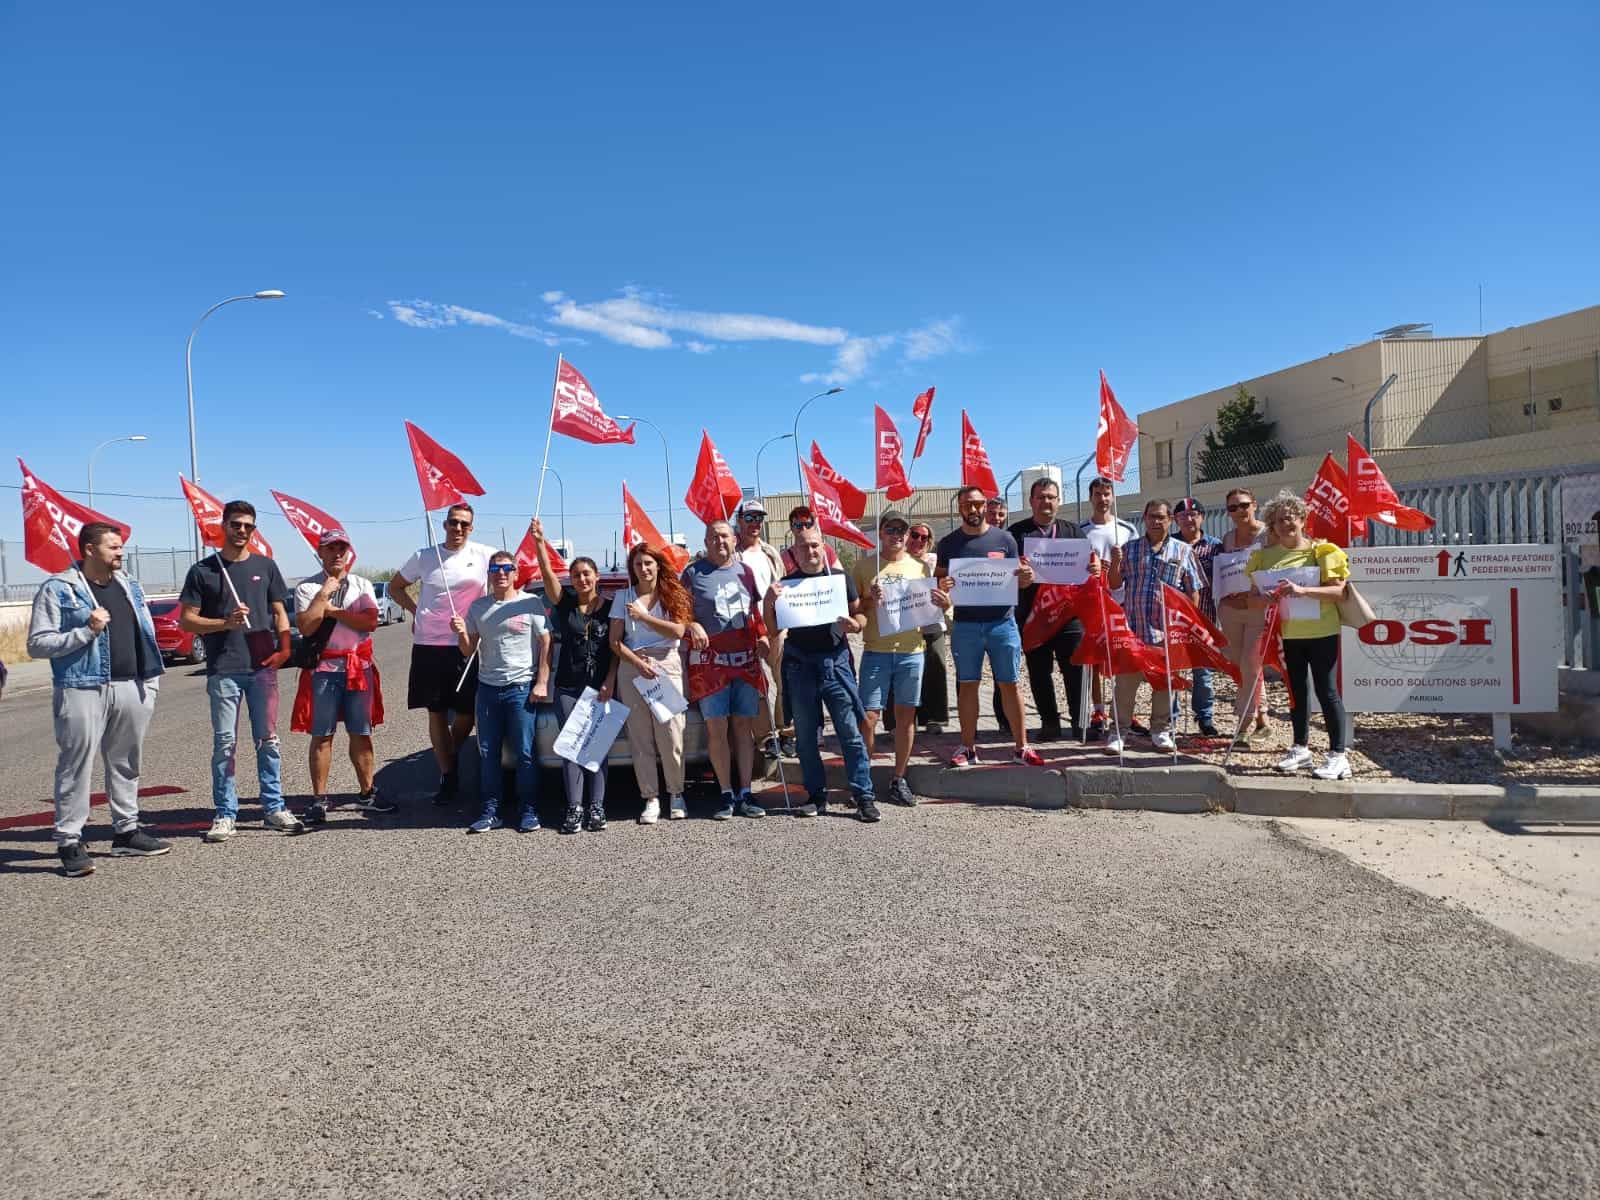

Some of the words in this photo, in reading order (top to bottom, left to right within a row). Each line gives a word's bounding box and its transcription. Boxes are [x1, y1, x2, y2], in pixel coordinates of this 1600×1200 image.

[1352, 556, 1391, 565] ENTRADA
[1392, 555, 1434, 564] CAMIONES
[1471, 555, 1510, 563] ENTRADA
[1511, 554, 1555, 562] PEATONES
[1365, 567, 1393, 575] TRUCK
[1394, 567, 1420, 575] ENTRY
[1472, 566, 1523, 574] PEDESTRIAN
[1524, 565, 1552, 574] ENTRY
[1358, 619, 1493, 645] OSI
[1354, 678, 1372, 687] OSI
[1374, 678, 1404, 687] FOOD
[1407, 678, 1467, 687] SOLUTIONS
[1470, 678, 1502, 687] SPAIN
